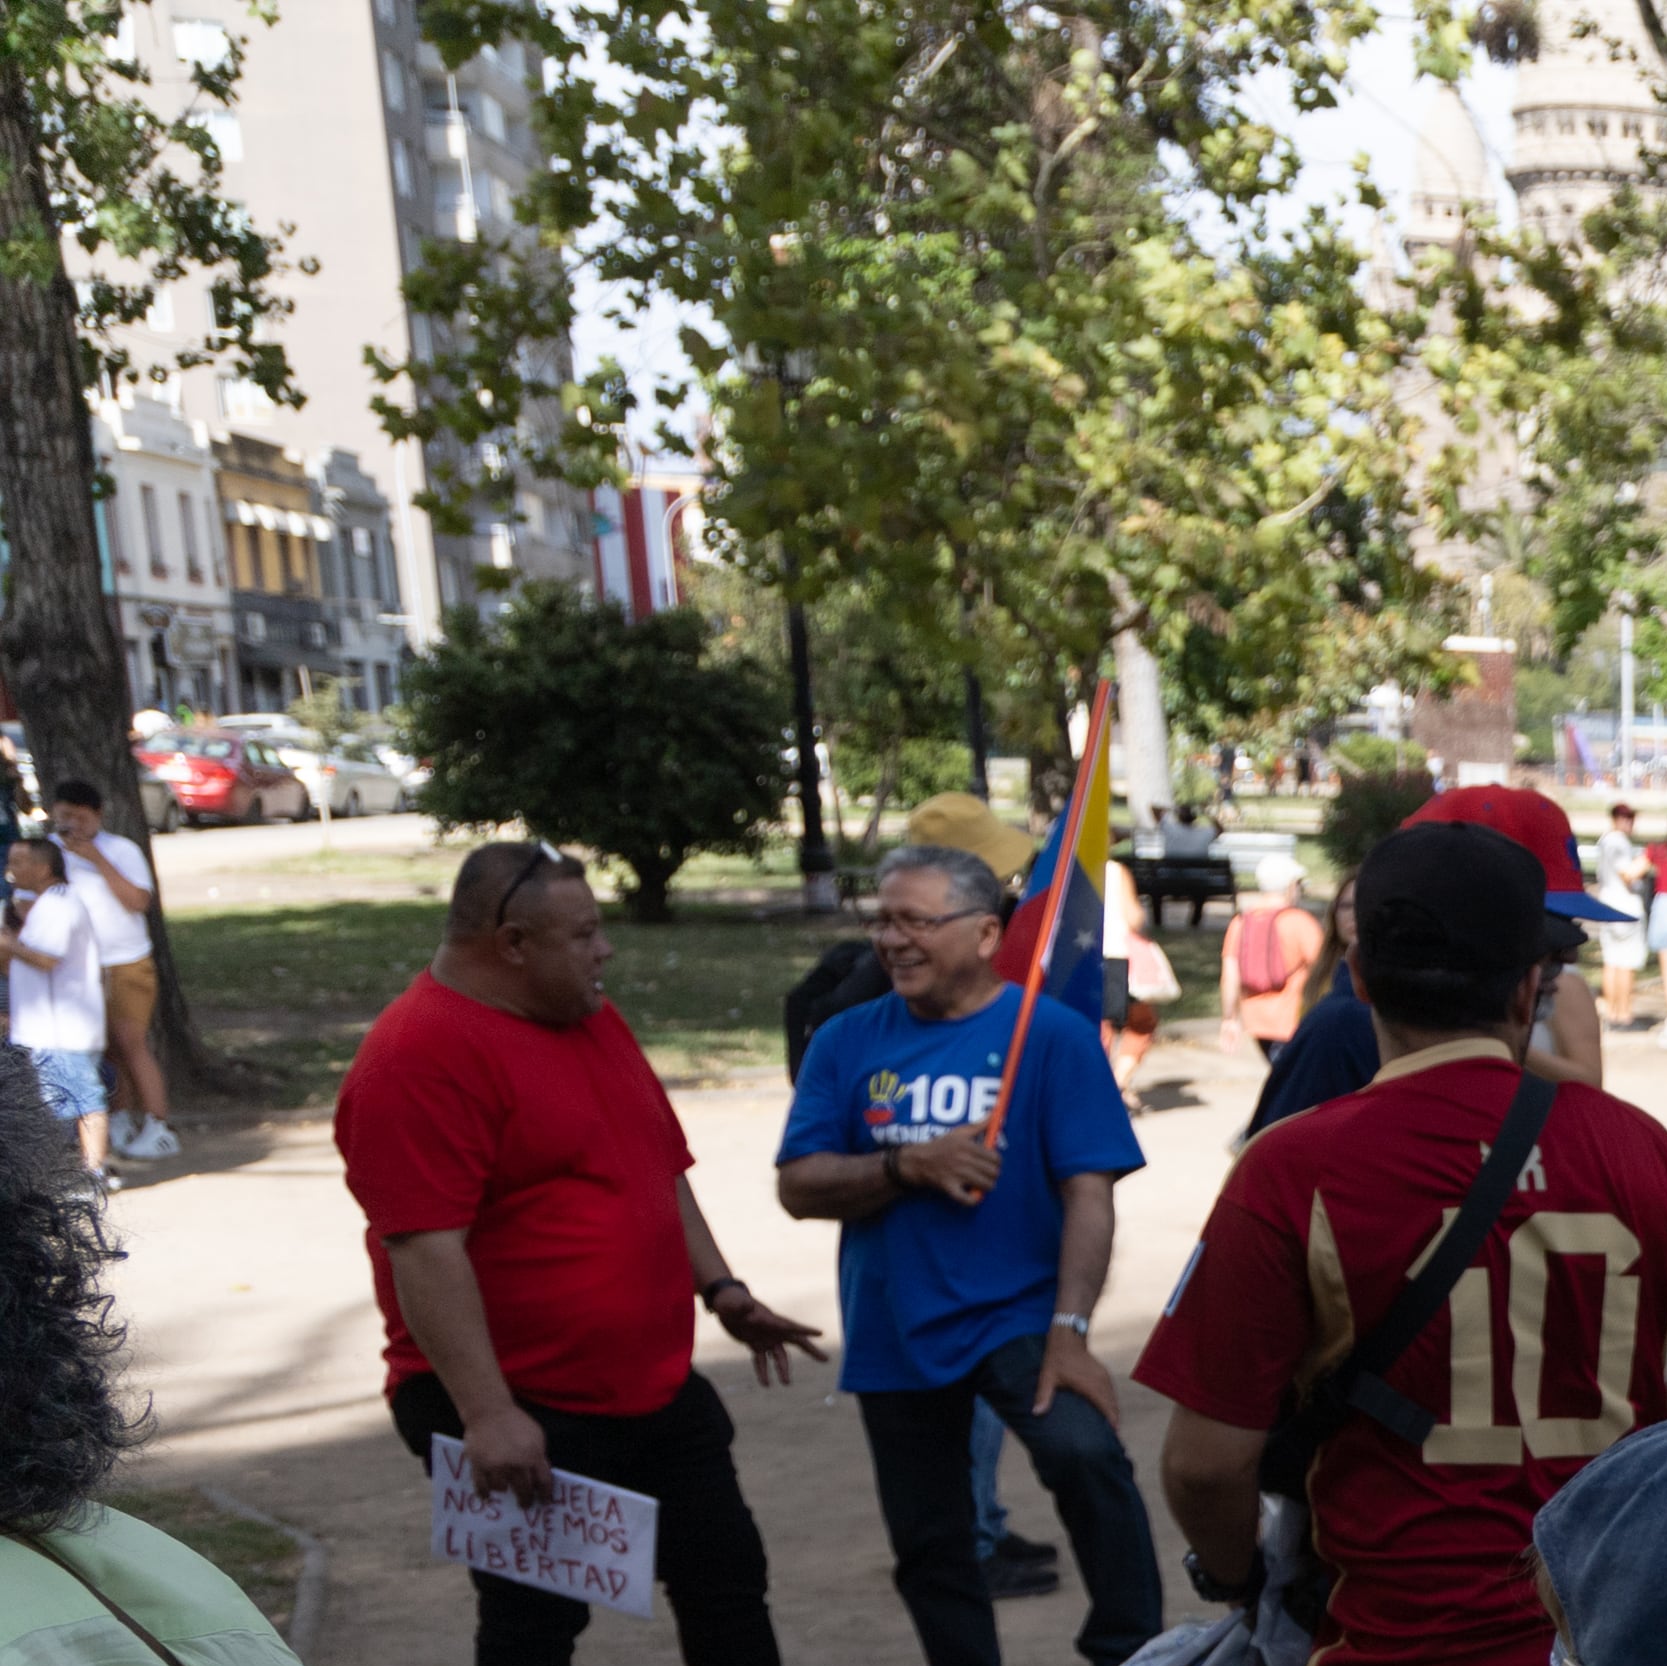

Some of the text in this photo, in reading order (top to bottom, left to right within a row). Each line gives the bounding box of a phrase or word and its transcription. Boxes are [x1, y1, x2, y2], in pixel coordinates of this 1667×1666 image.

[1406, 1206, 1641, 1465] 10
[444, 1487, 629, 1555] NOS VEMOS
[510, 1526, 549, 1552] EN
[446, 1525, 627, 1599] LIBERTAD
